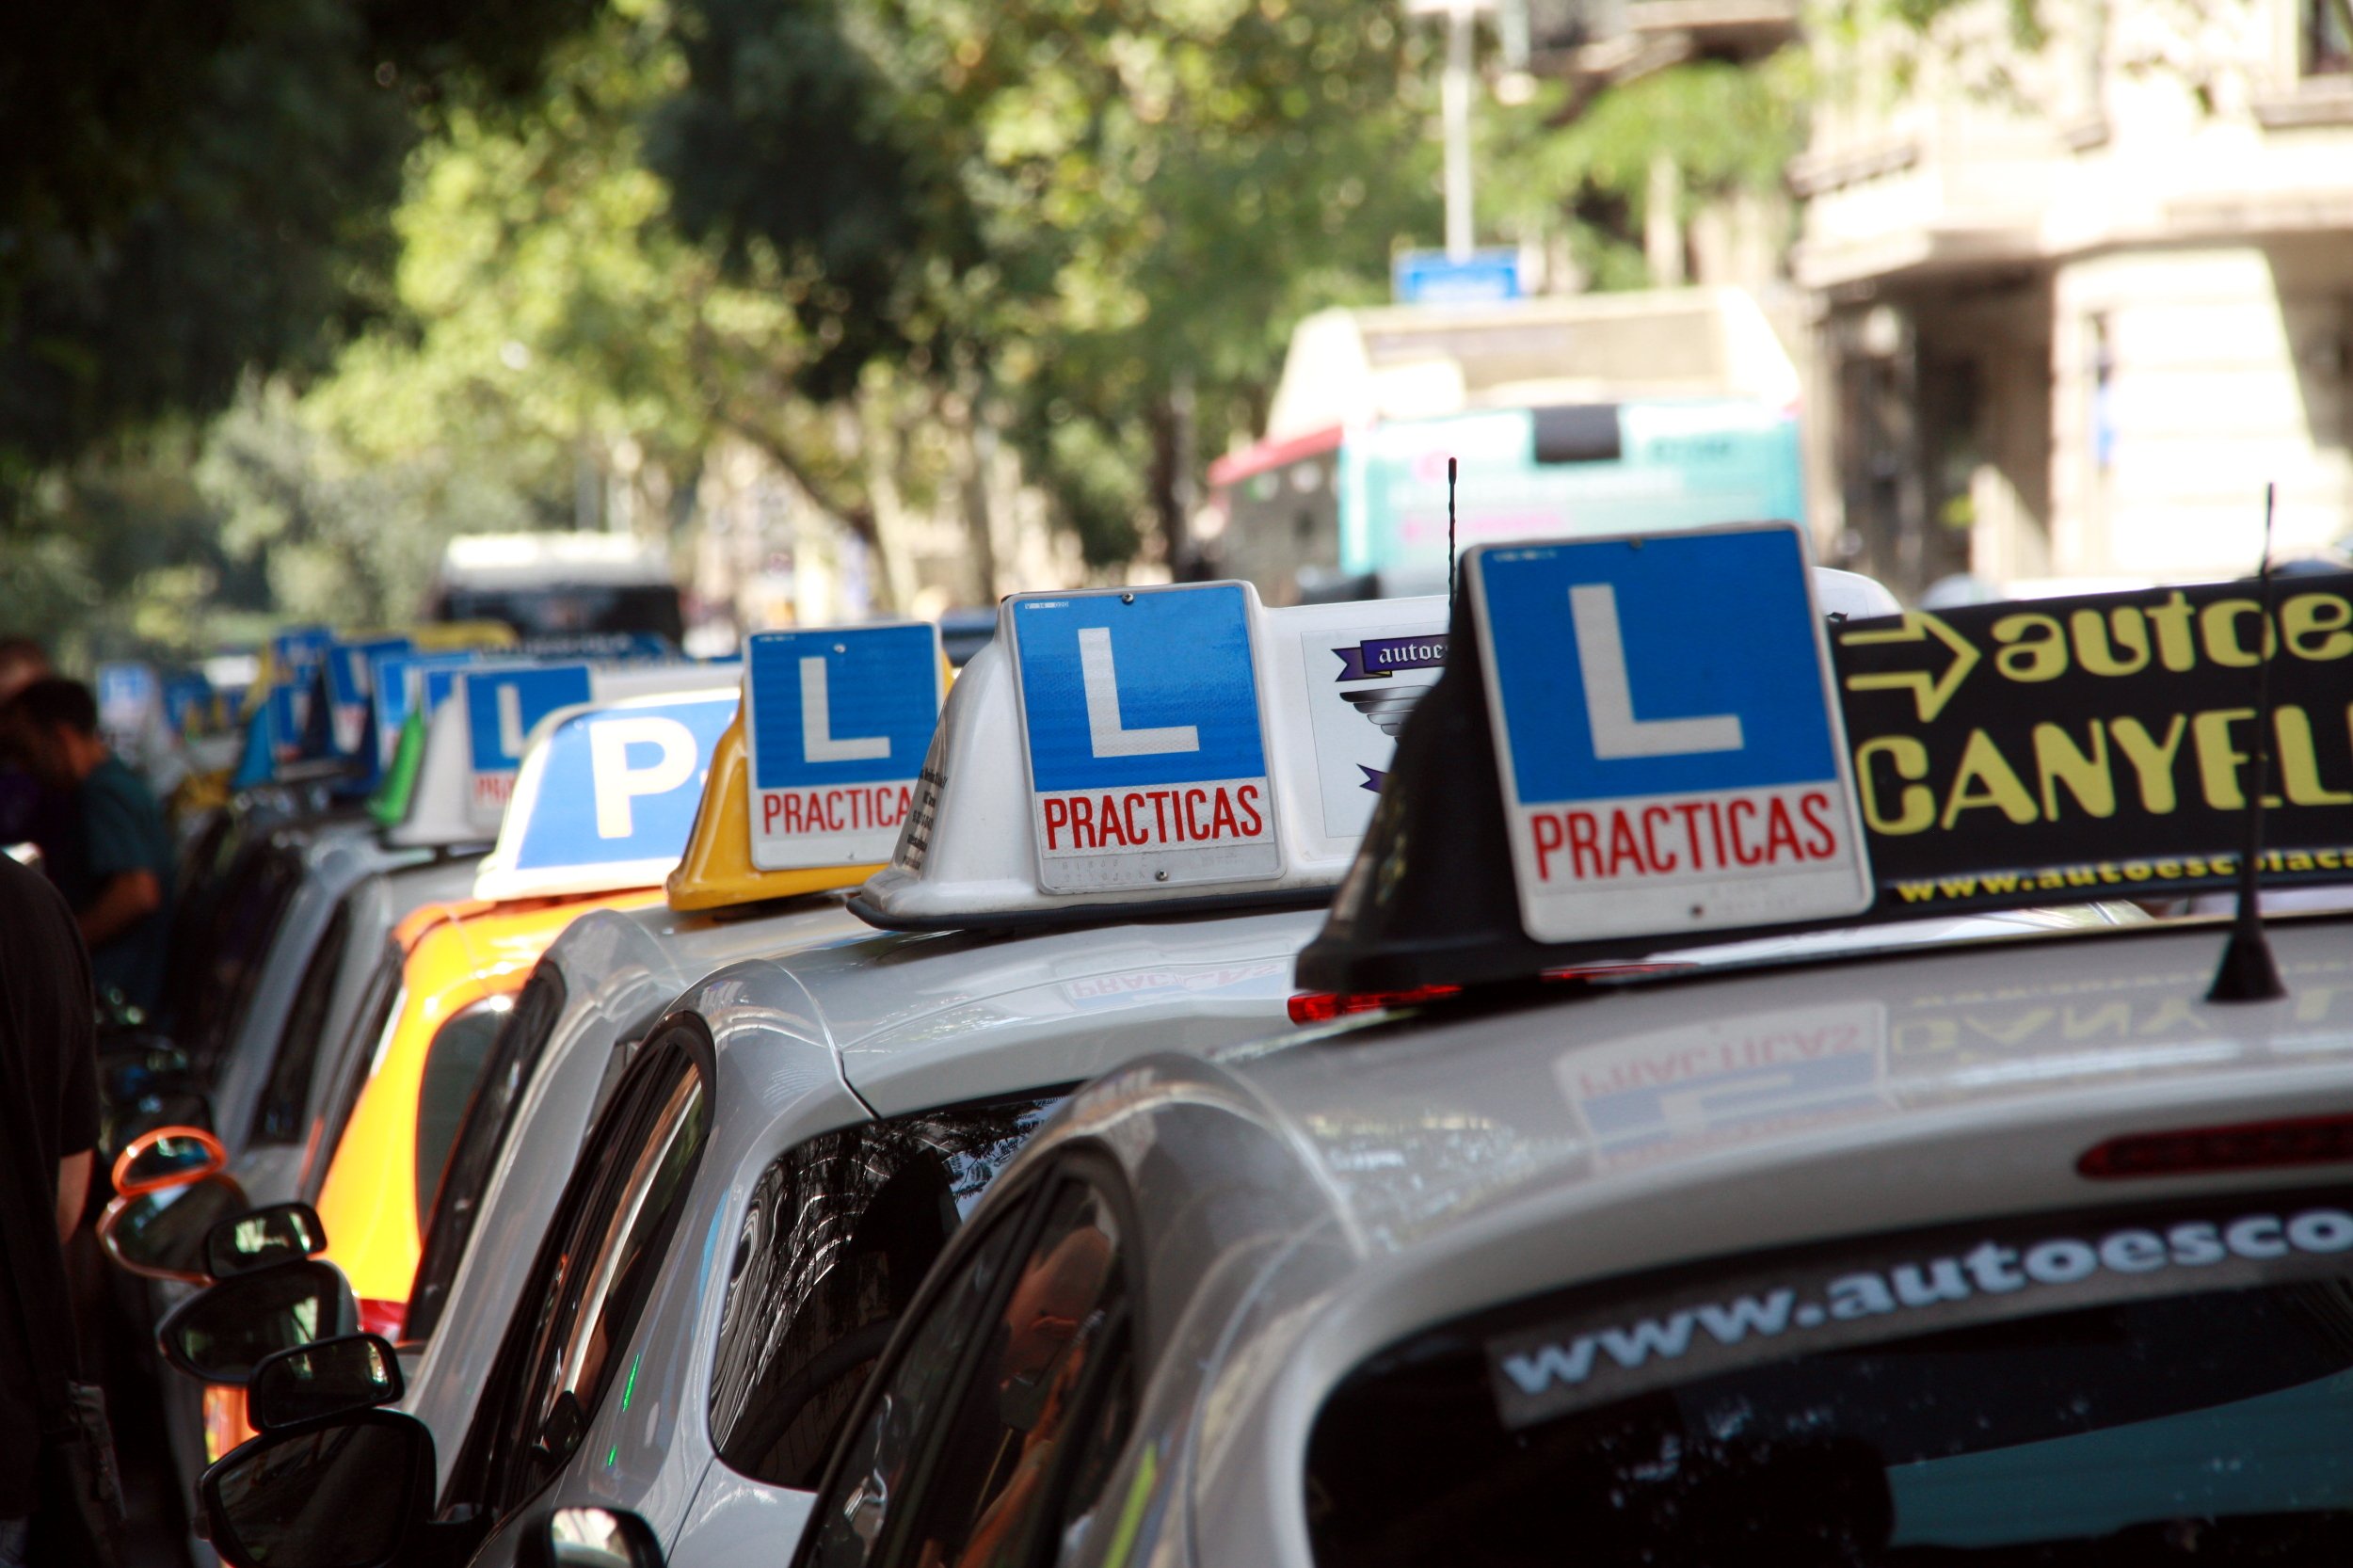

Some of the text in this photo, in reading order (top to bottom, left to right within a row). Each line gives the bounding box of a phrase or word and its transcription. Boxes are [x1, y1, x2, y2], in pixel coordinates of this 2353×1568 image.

[1379, 643, 1449, 664] autoe
[1569, 583, 1743, 760] L
[1991, 590, 2353, 682] autoe
[800, 656, 891, 763] L
[1078, 627, 1200, 759] L
[589, 716, 697, 840] P
[762, 787, 911, 835] PRACTICA
[1044, 785, 1263, 851] PRACTICAS
[1855, 703, 2353, 835] CANYEL
[1530, 791, 1837, 883] PRACTICAS
[1896, 849, 2353, 903] www.autoesclac
[1503, 1208, 2353, 1396] www.autoesco
